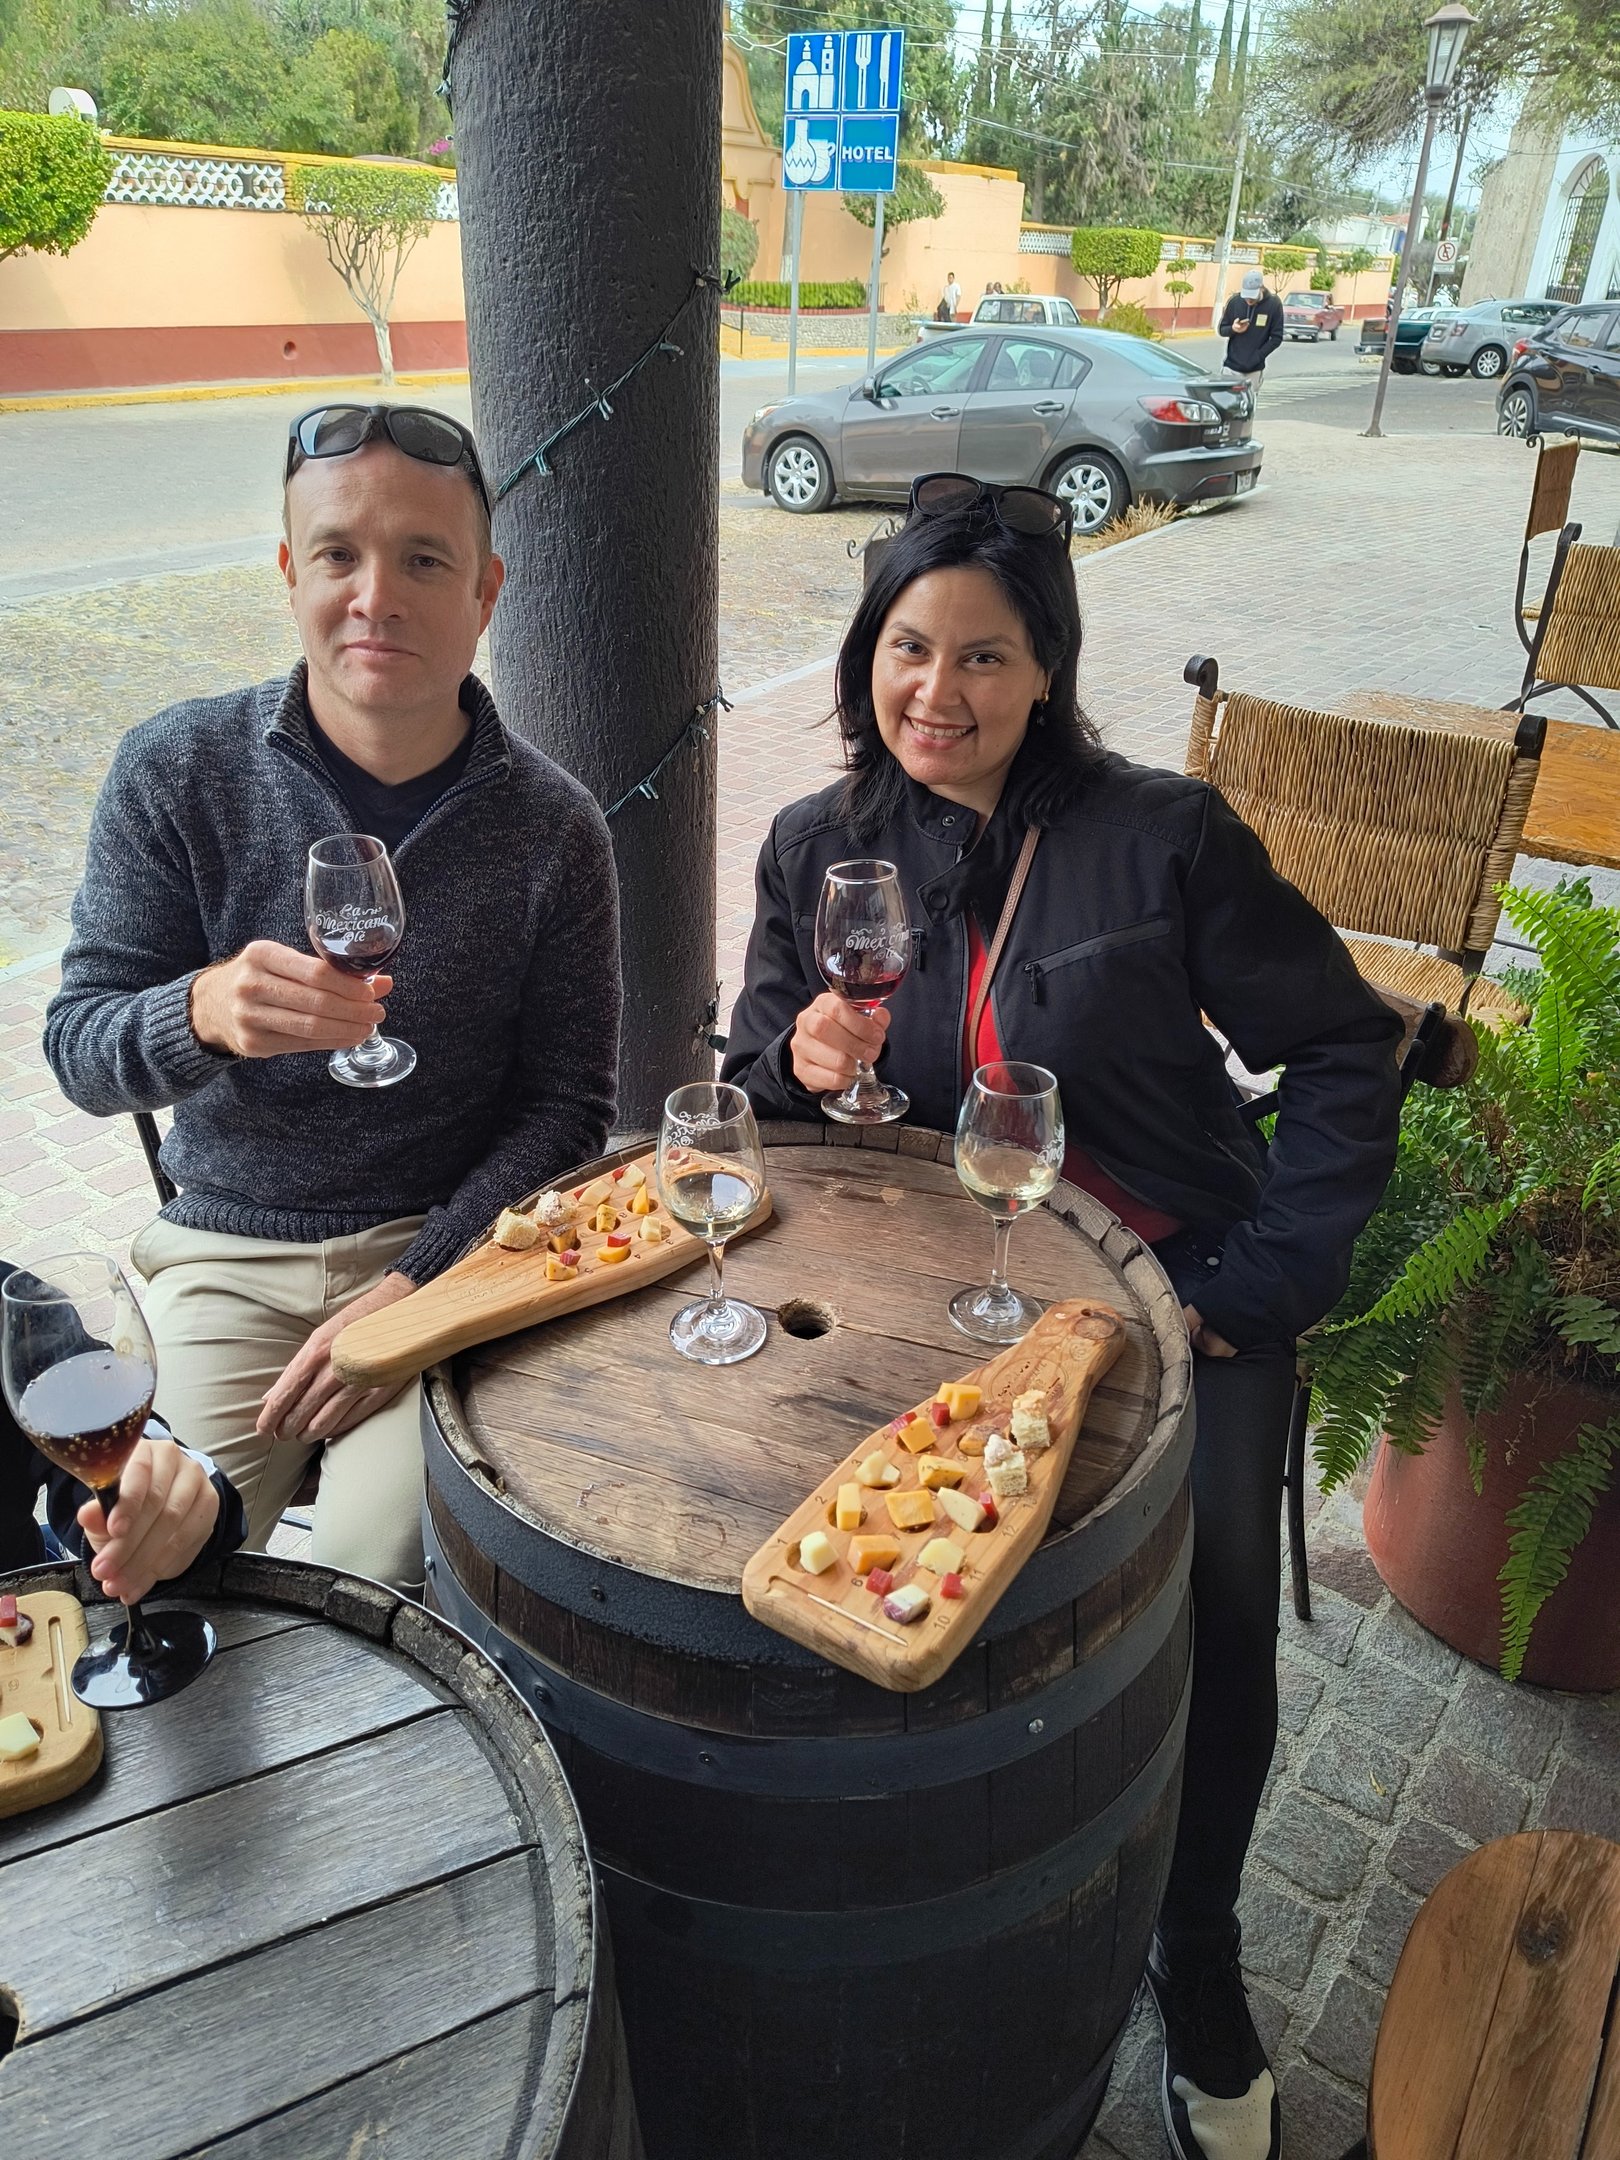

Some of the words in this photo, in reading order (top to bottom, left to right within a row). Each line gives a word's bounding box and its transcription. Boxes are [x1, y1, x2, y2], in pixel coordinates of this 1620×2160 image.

[842, 145, 894, 160] HOTEL
[339, 904, 361, 920] La
[316, 914, 395, 935] Mexicana
[846, 930, 909, 951] Mexca
[815, 1495, 827, 1504] 2
[1002, 1524, 1020, 1537] 12
[969, 1568, 986, 1581] 11
[851, 1578, 863, 1587] 6
[933, 1615, 951, 1631] 10
